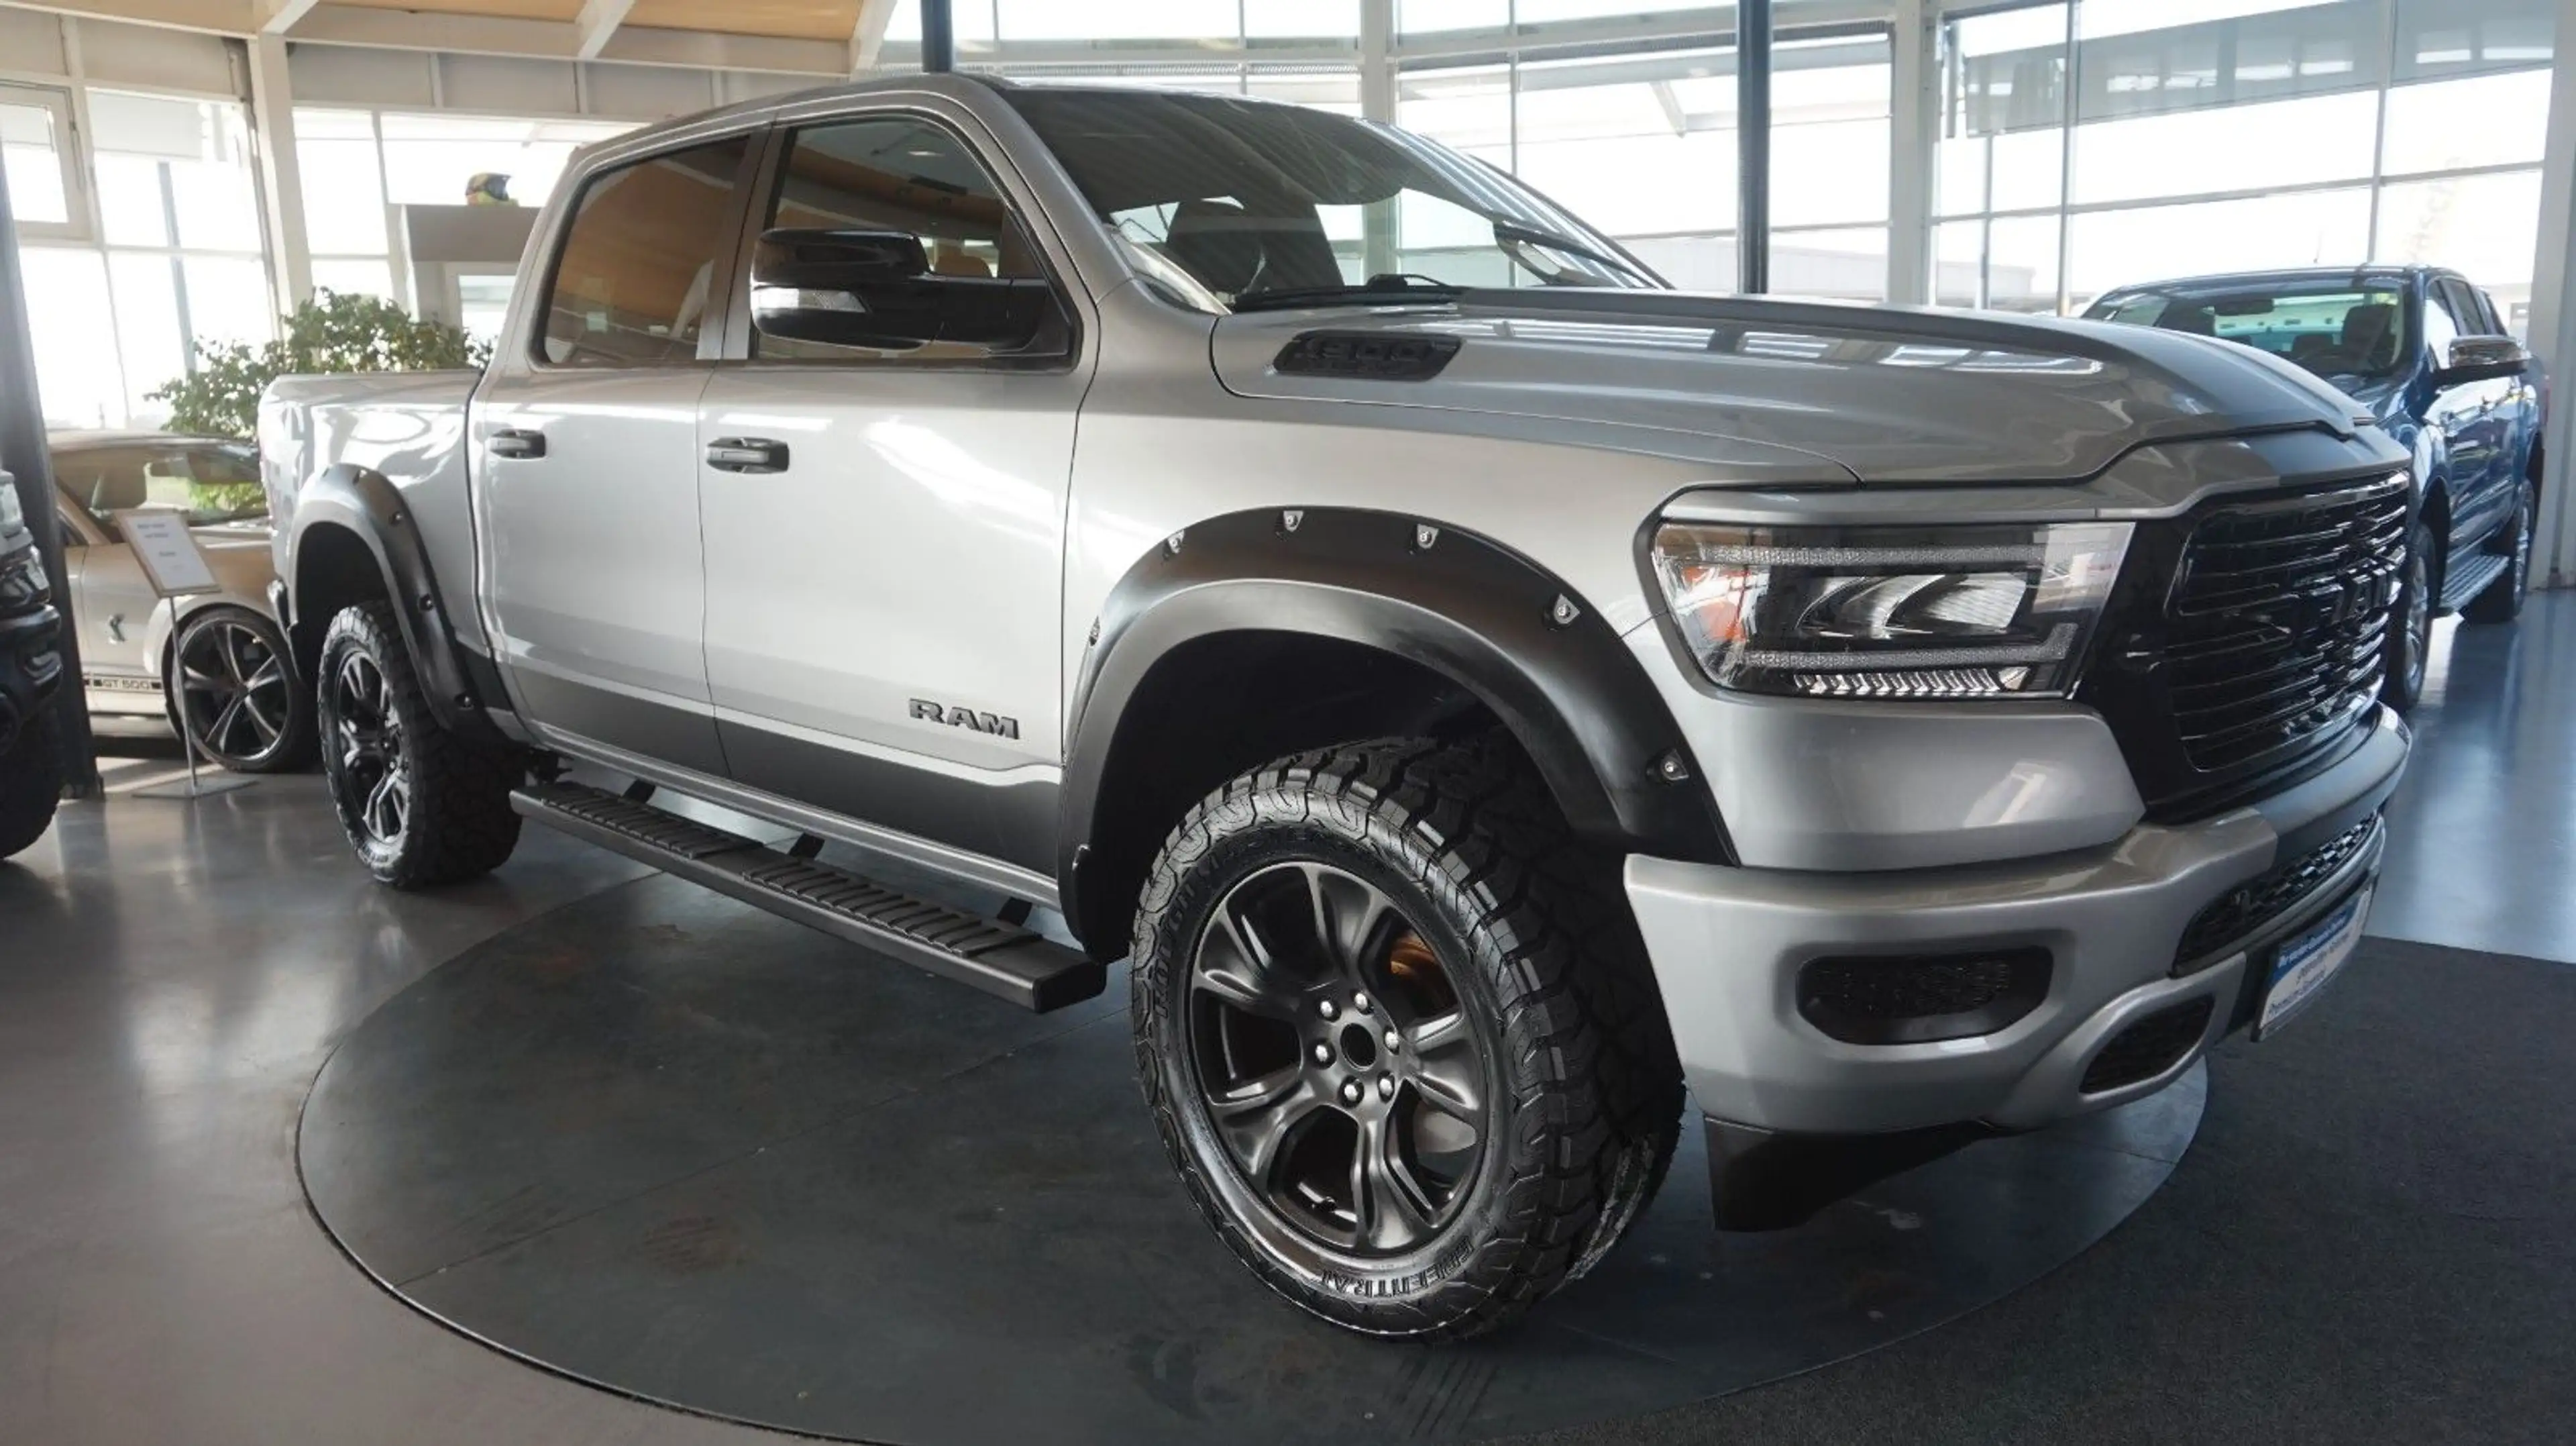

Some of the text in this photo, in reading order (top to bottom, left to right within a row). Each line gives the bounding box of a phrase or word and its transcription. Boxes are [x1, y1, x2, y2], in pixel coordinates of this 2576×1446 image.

[102, 678, 150, 690] GT 500
[910, 698, 1019, 739] RAM
